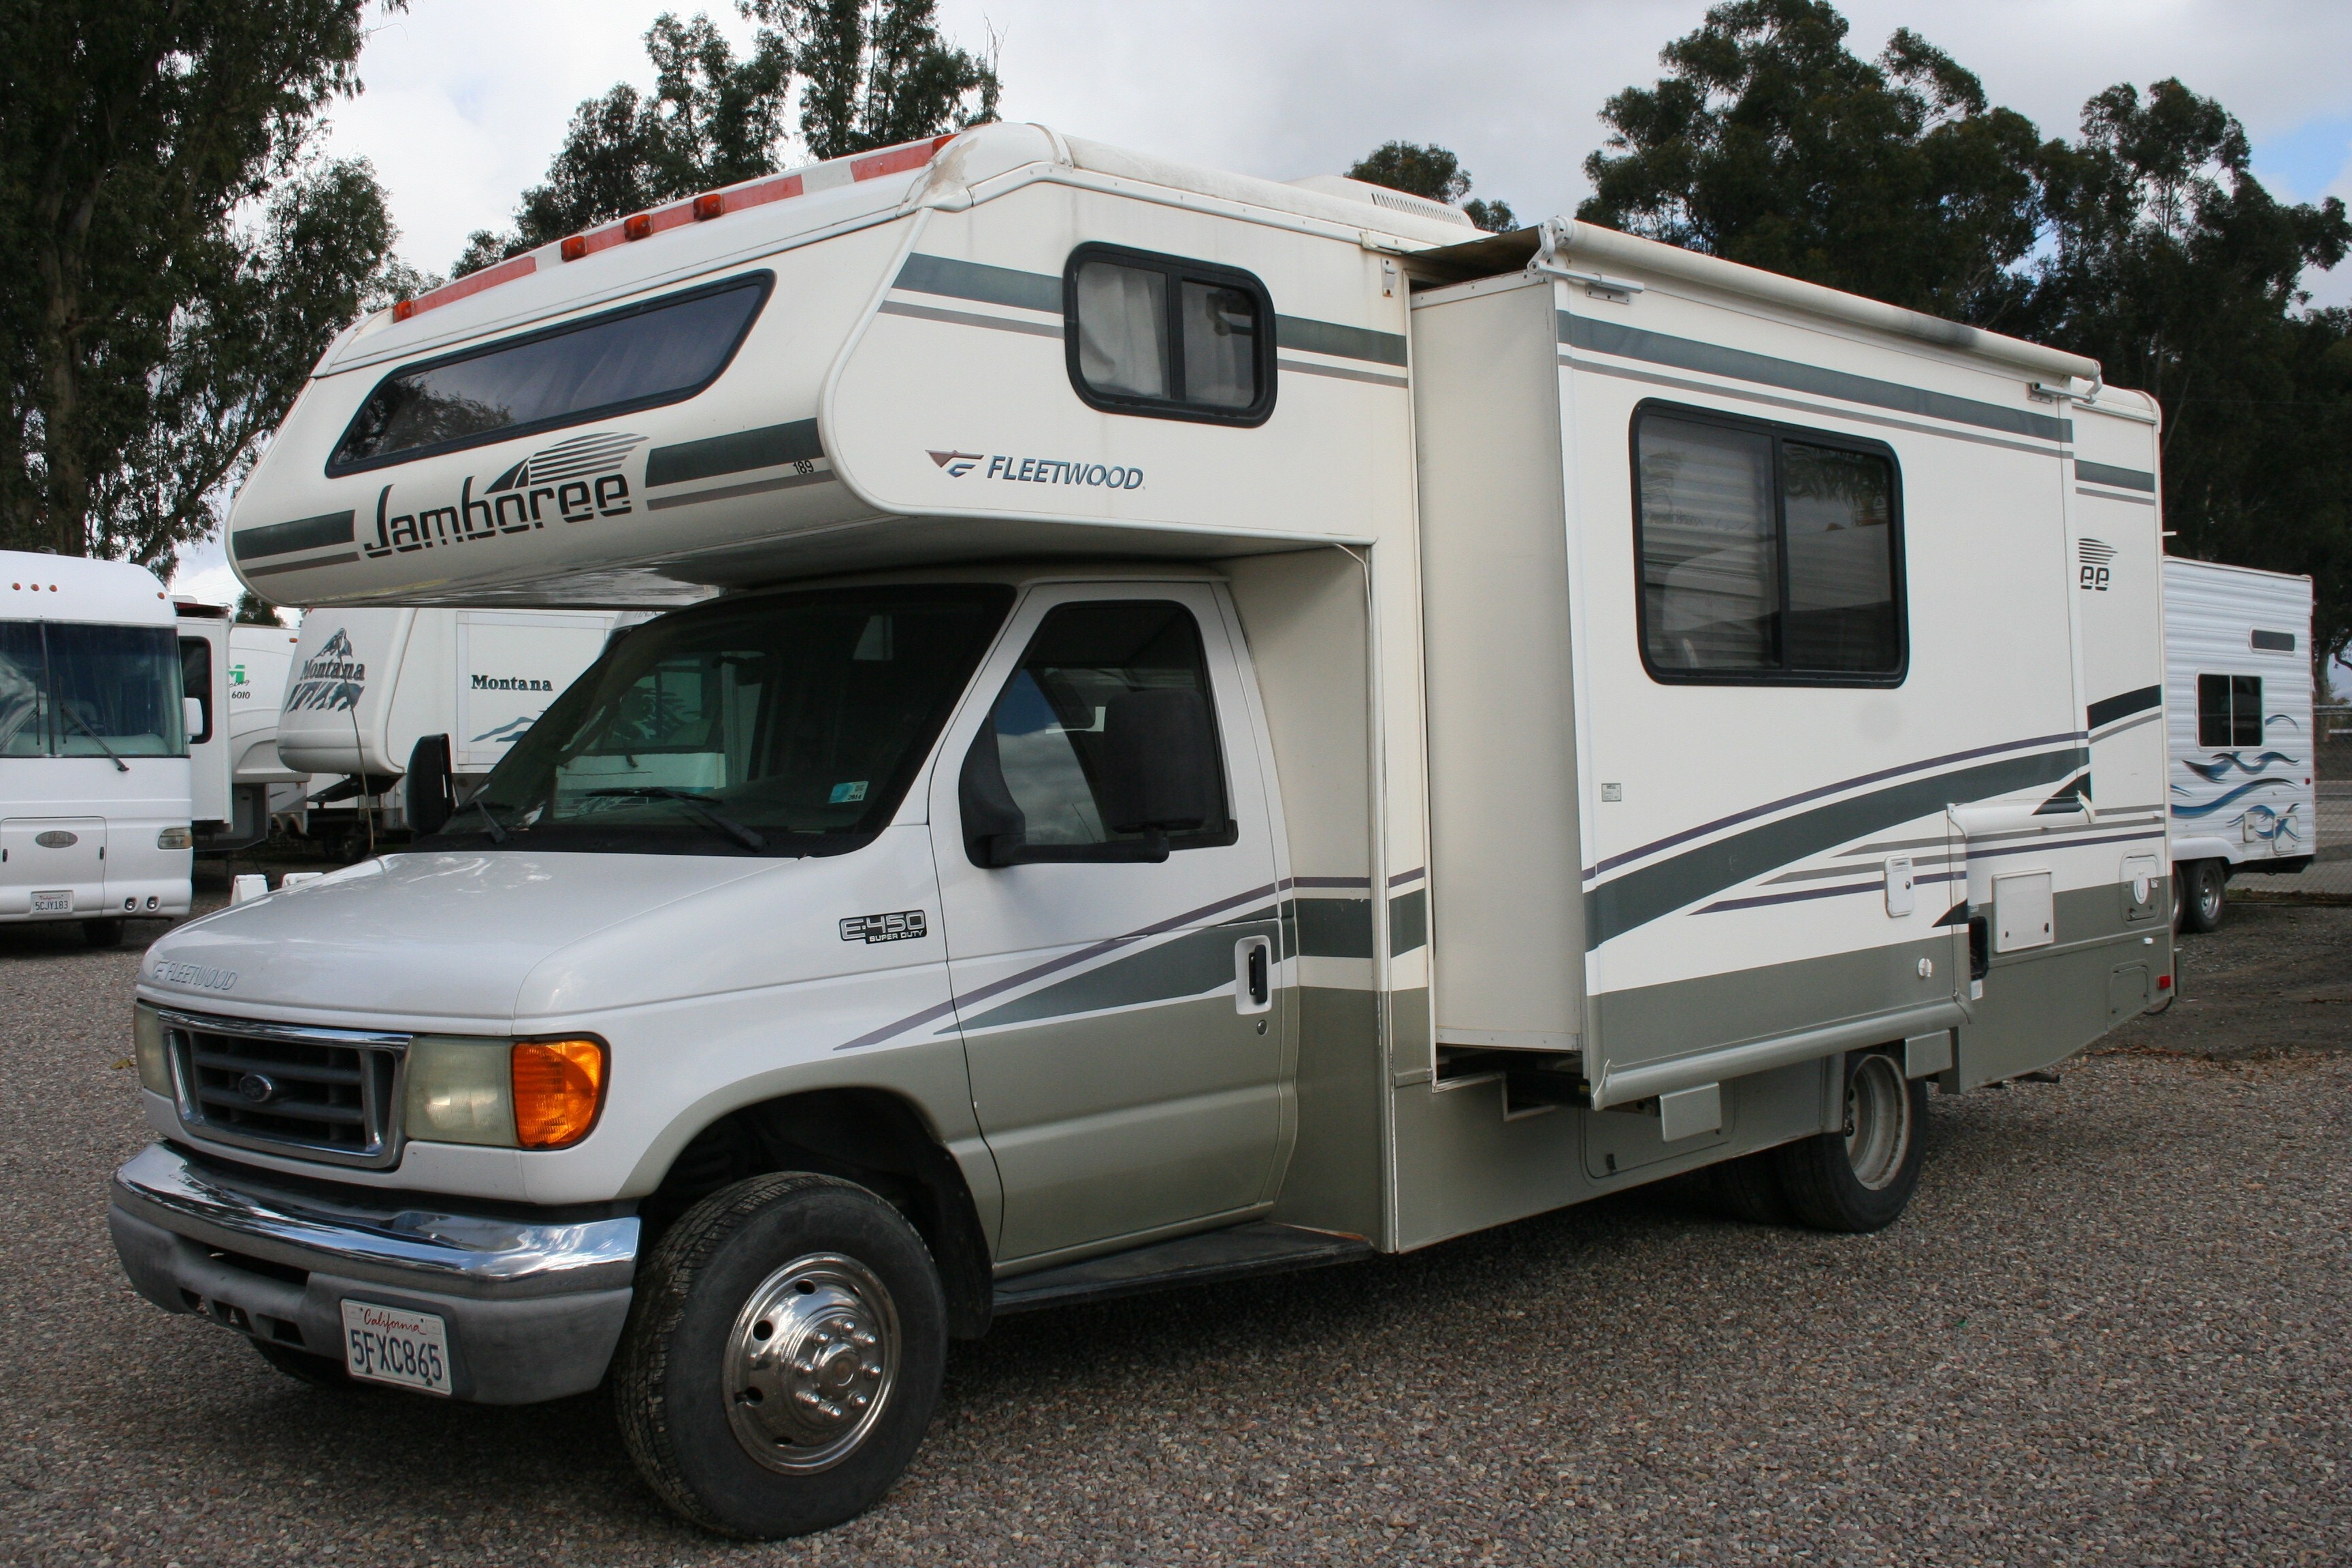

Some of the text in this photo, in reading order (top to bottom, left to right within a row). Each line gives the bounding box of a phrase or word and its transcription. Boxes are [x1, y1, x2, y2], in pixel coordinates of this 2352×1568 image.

[792, 460, 814, 474] 189
[987, 455, 1143, 489] FLEETWOOD
[363, 475, 632, 559] Jamboree
[300, 659, 365, 681] Montana
[471, 674, 553, 691] Montana
[35, 900, 69, 911] 5CJY183
[869, 930, 924, 942] SUPER DUTY
[164, 962, 238, 990] FLEETWOOD
[364, 1309, 427, 1335] California
[350, 1329, 442, 1381] 5FXC865
